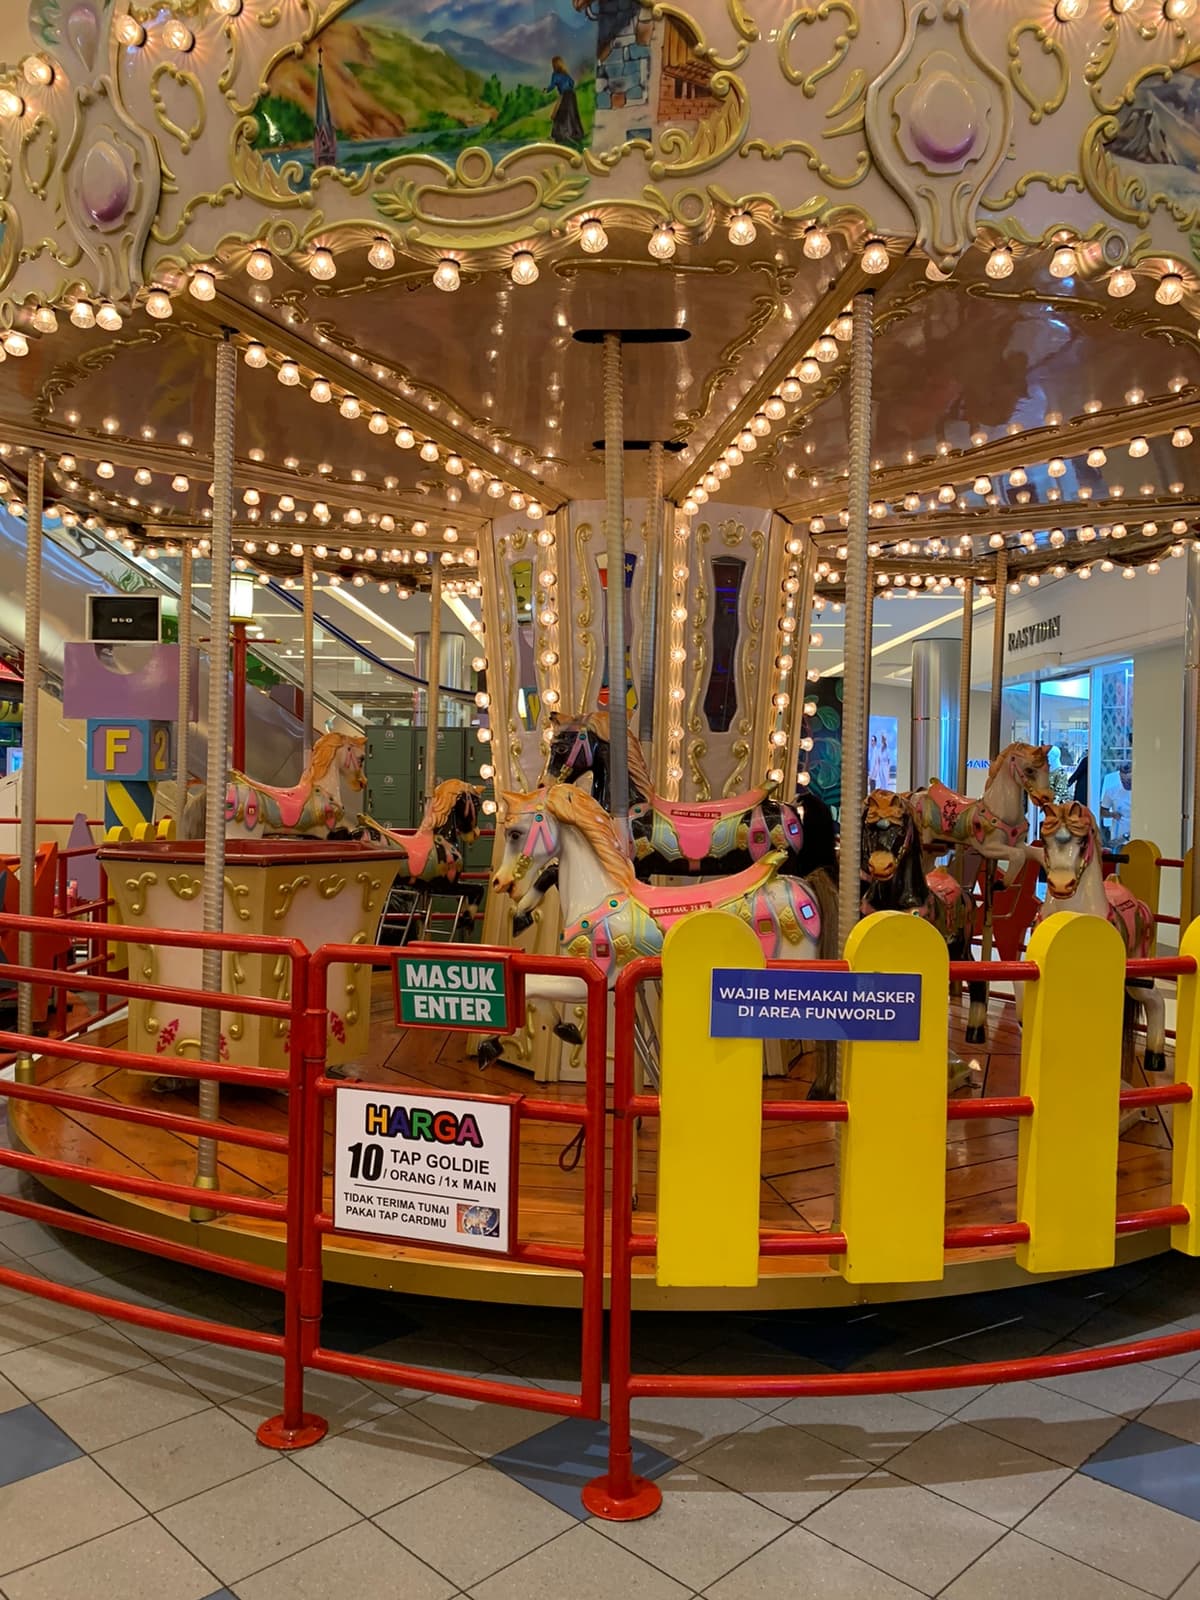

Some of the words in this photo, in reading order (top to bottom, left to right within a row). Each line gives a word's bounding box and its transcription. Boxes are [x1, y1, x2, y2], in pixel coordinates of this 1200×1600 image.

[106, 729, 130, 771] F
[154, 729, 166, 771] 2
[405, 963, 497, 991] MASUK
[413, 995, 493, 1023] ENTER
[719, 987, 770, 1000] WAJIB
[774, 989, 848, 1002] MEMAKAI
[852, 991, 916, 1004] MASKER
[738, 1005, 754, 1017] DI
[758, 1006, 801, 1018] AREA
[805, 1007, 896, 1021] FUNWORLD
[365, 1103, 483, 1148] HARGA
[348, 1142, 384, 1182] 10
[390, 1149, 421, 1166] TAP
[426, 1154, 490, 1175] GOLDIE
[463, 1178, 497, 1193] MAIN
[343, 1192, 374, 1205] TIDAK
[376, 1196, 416, 1211] TERIMA
[418, 1202, 449, 1215] TUNAI
[345, 1205, 376, 1218] PAKAI
[378, 1210, 398, 1220] TAP
[400, 1213, 447, 1229] CARDMU
